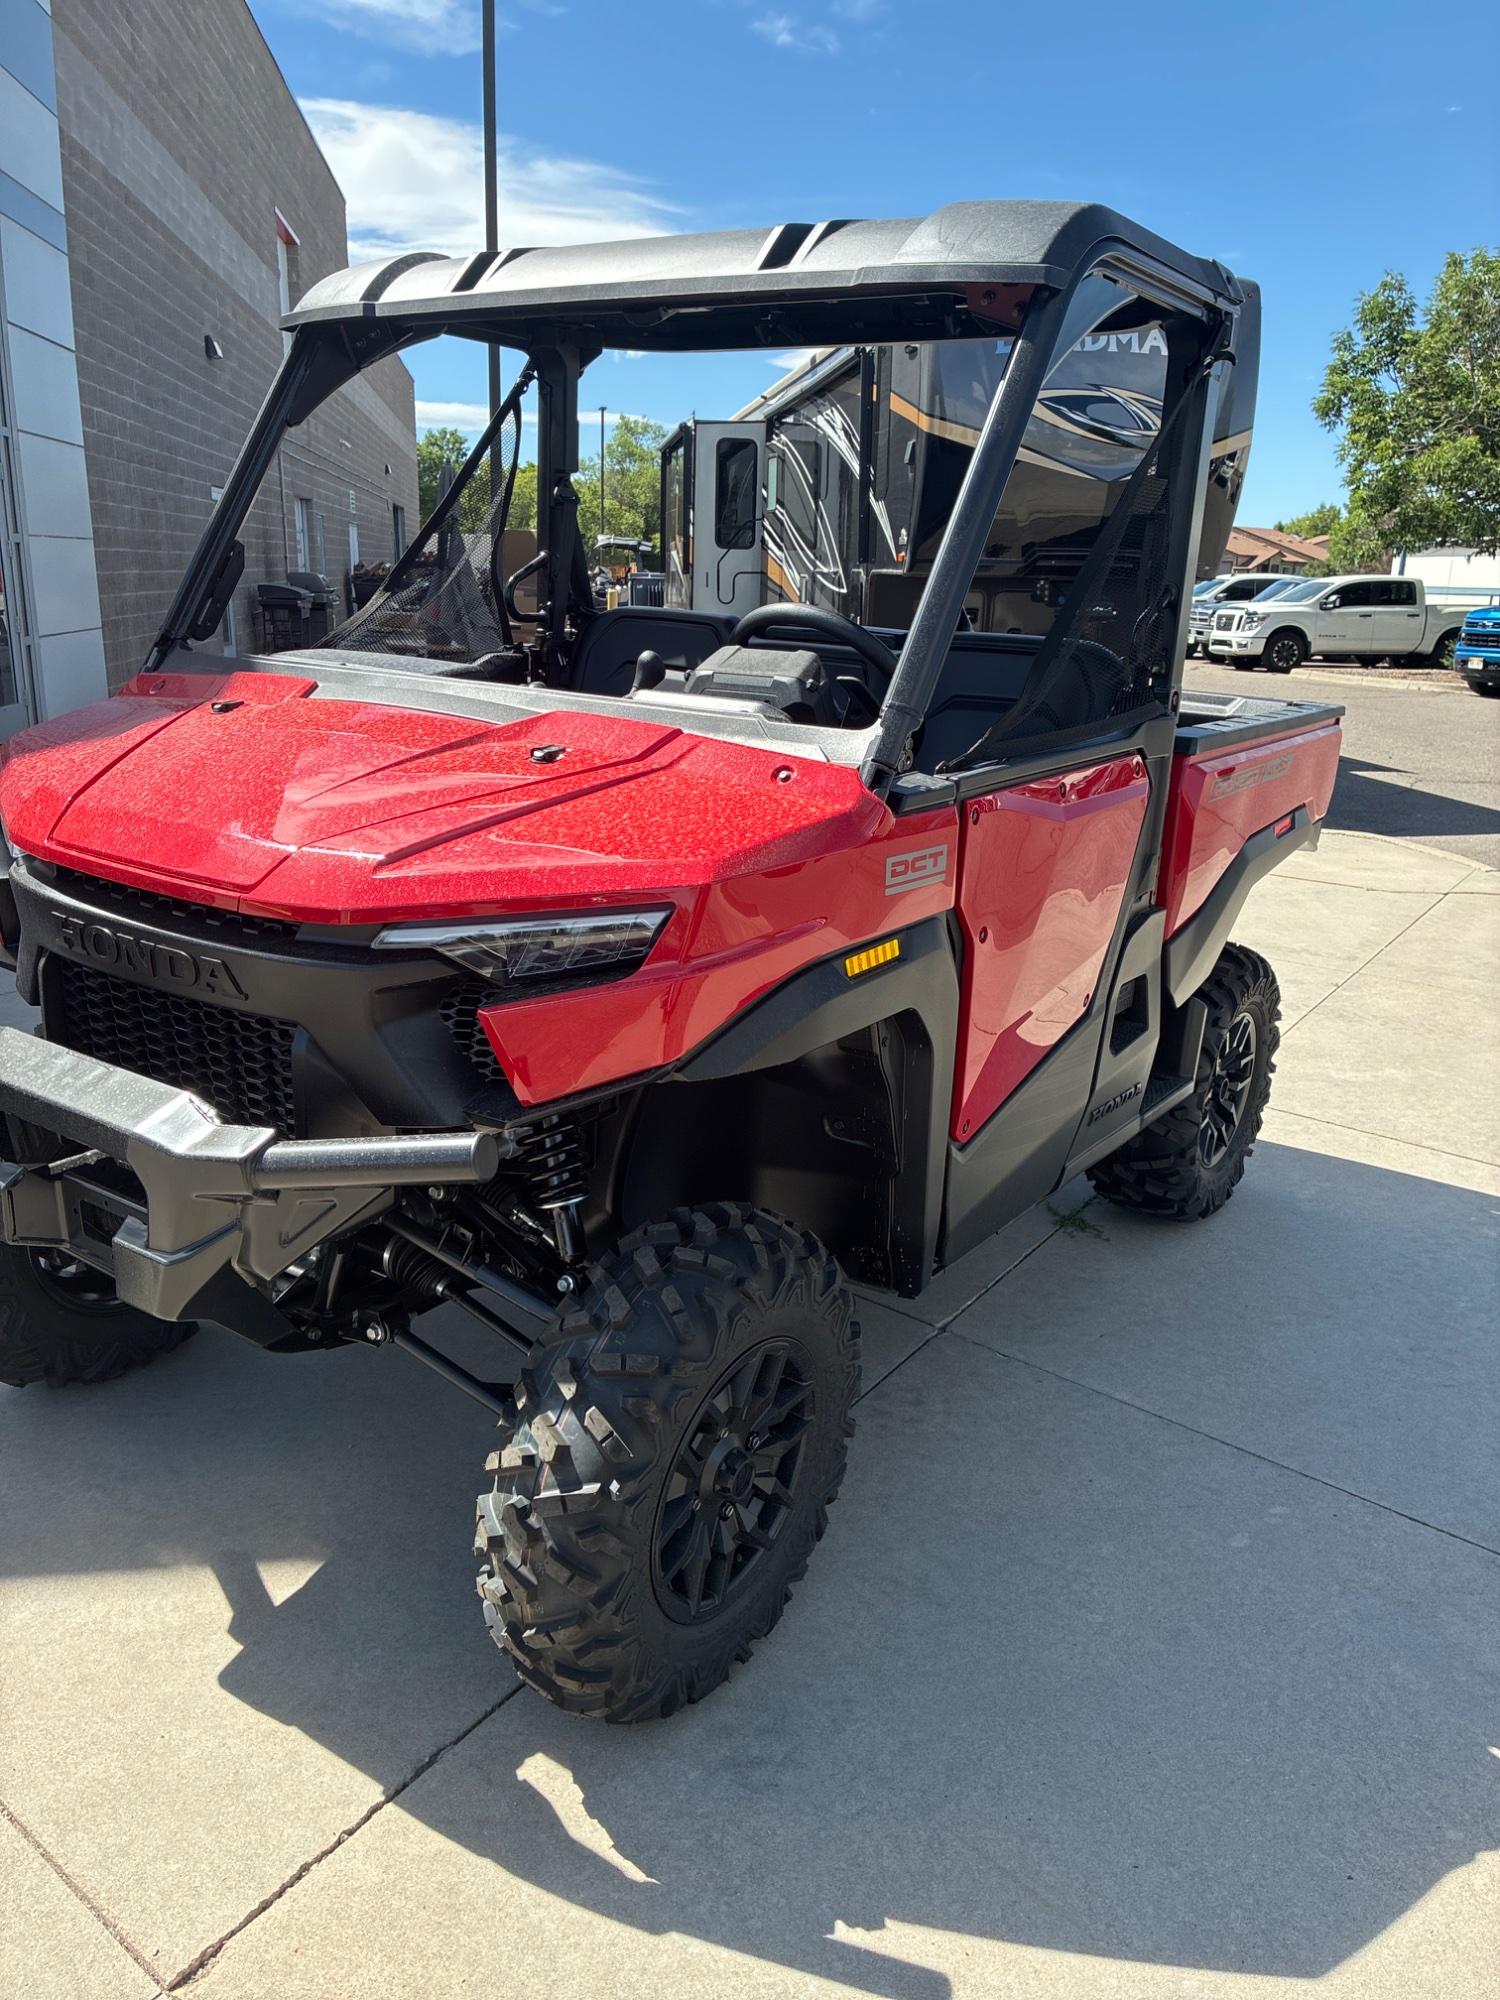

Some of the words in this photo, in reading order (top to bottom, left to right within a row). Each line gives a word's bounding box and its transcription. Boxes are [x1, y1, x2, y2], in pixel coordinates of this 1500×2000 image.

[890, 850, 944, 879] DCT
[51, 911, 249, 1001] HONDA
[1087, 1081, 1143, 1127] HONDA
